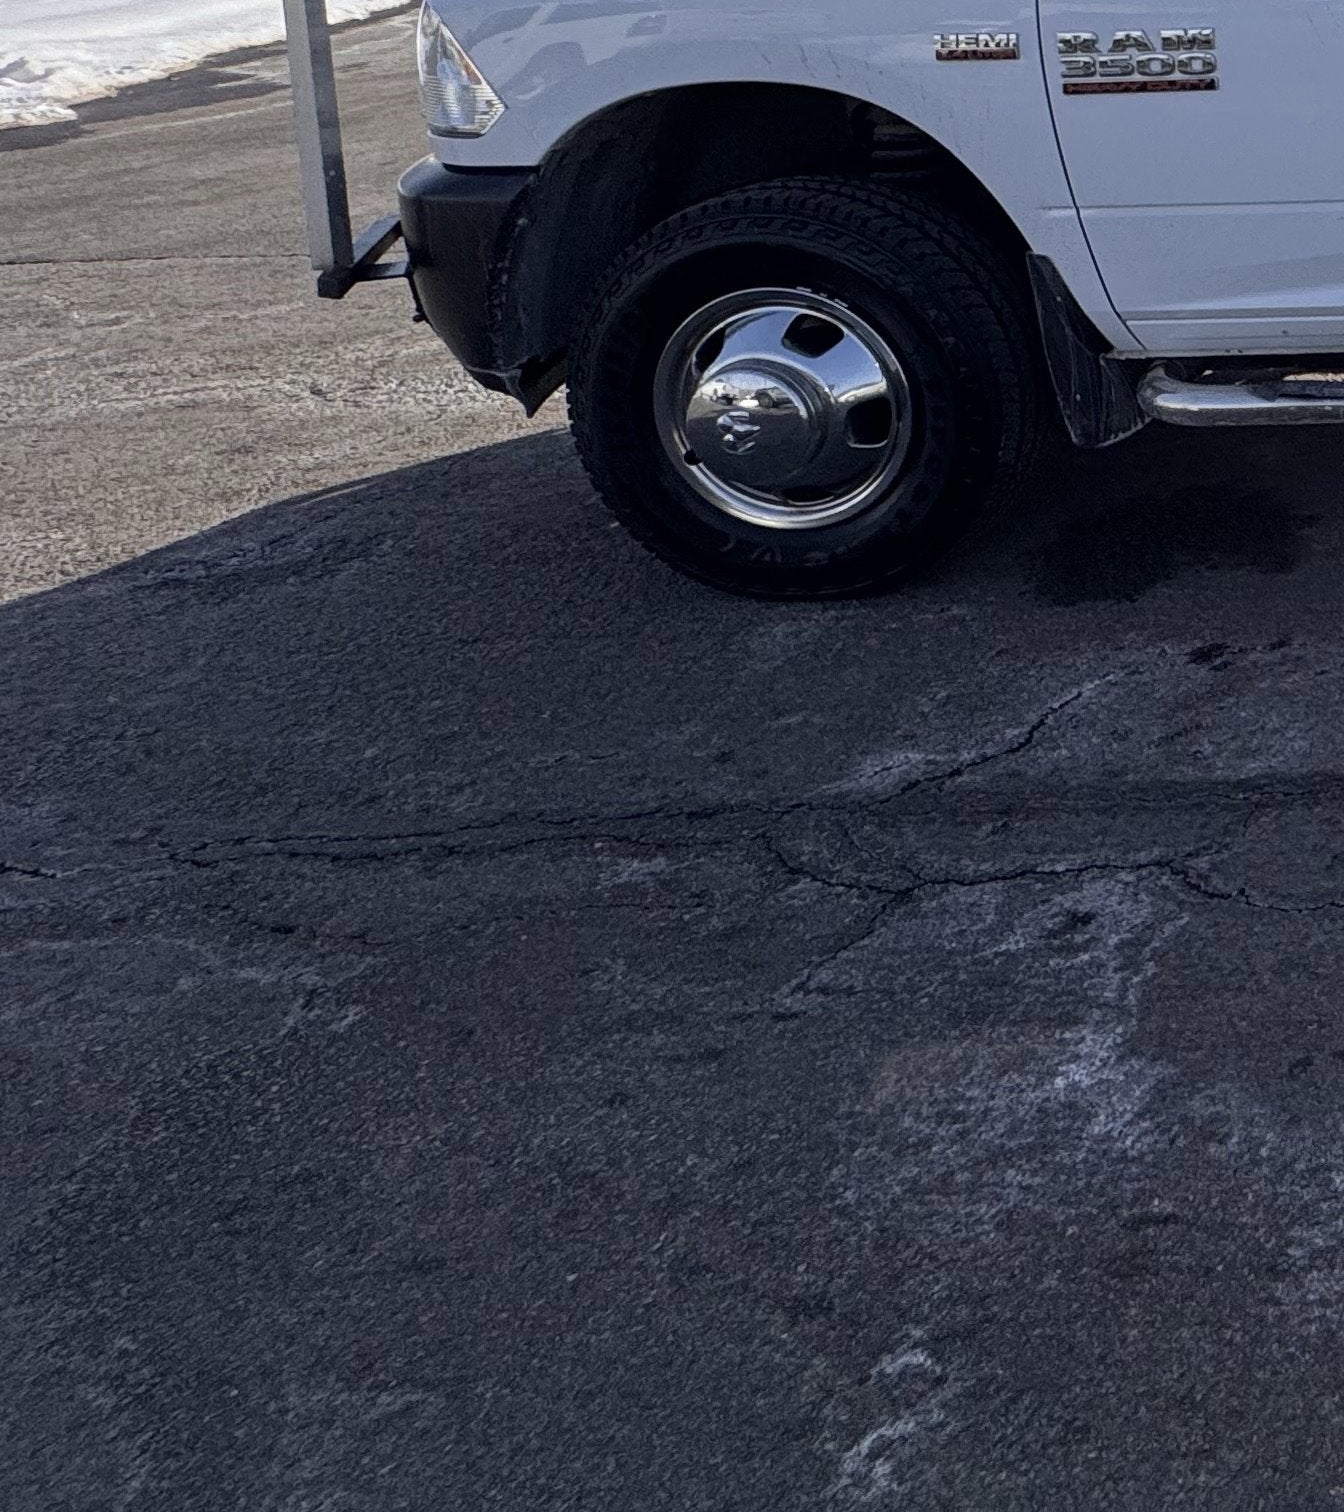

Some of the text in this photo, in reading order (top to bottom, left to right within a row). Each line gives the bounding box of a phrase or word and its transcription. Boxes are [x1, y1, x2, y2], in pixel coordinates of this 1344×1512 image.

[933, 33, 1018, 49] HEMI
[1056, 28, 1216, 54] RAM
[1059, 52, 1218, 78] 3500
